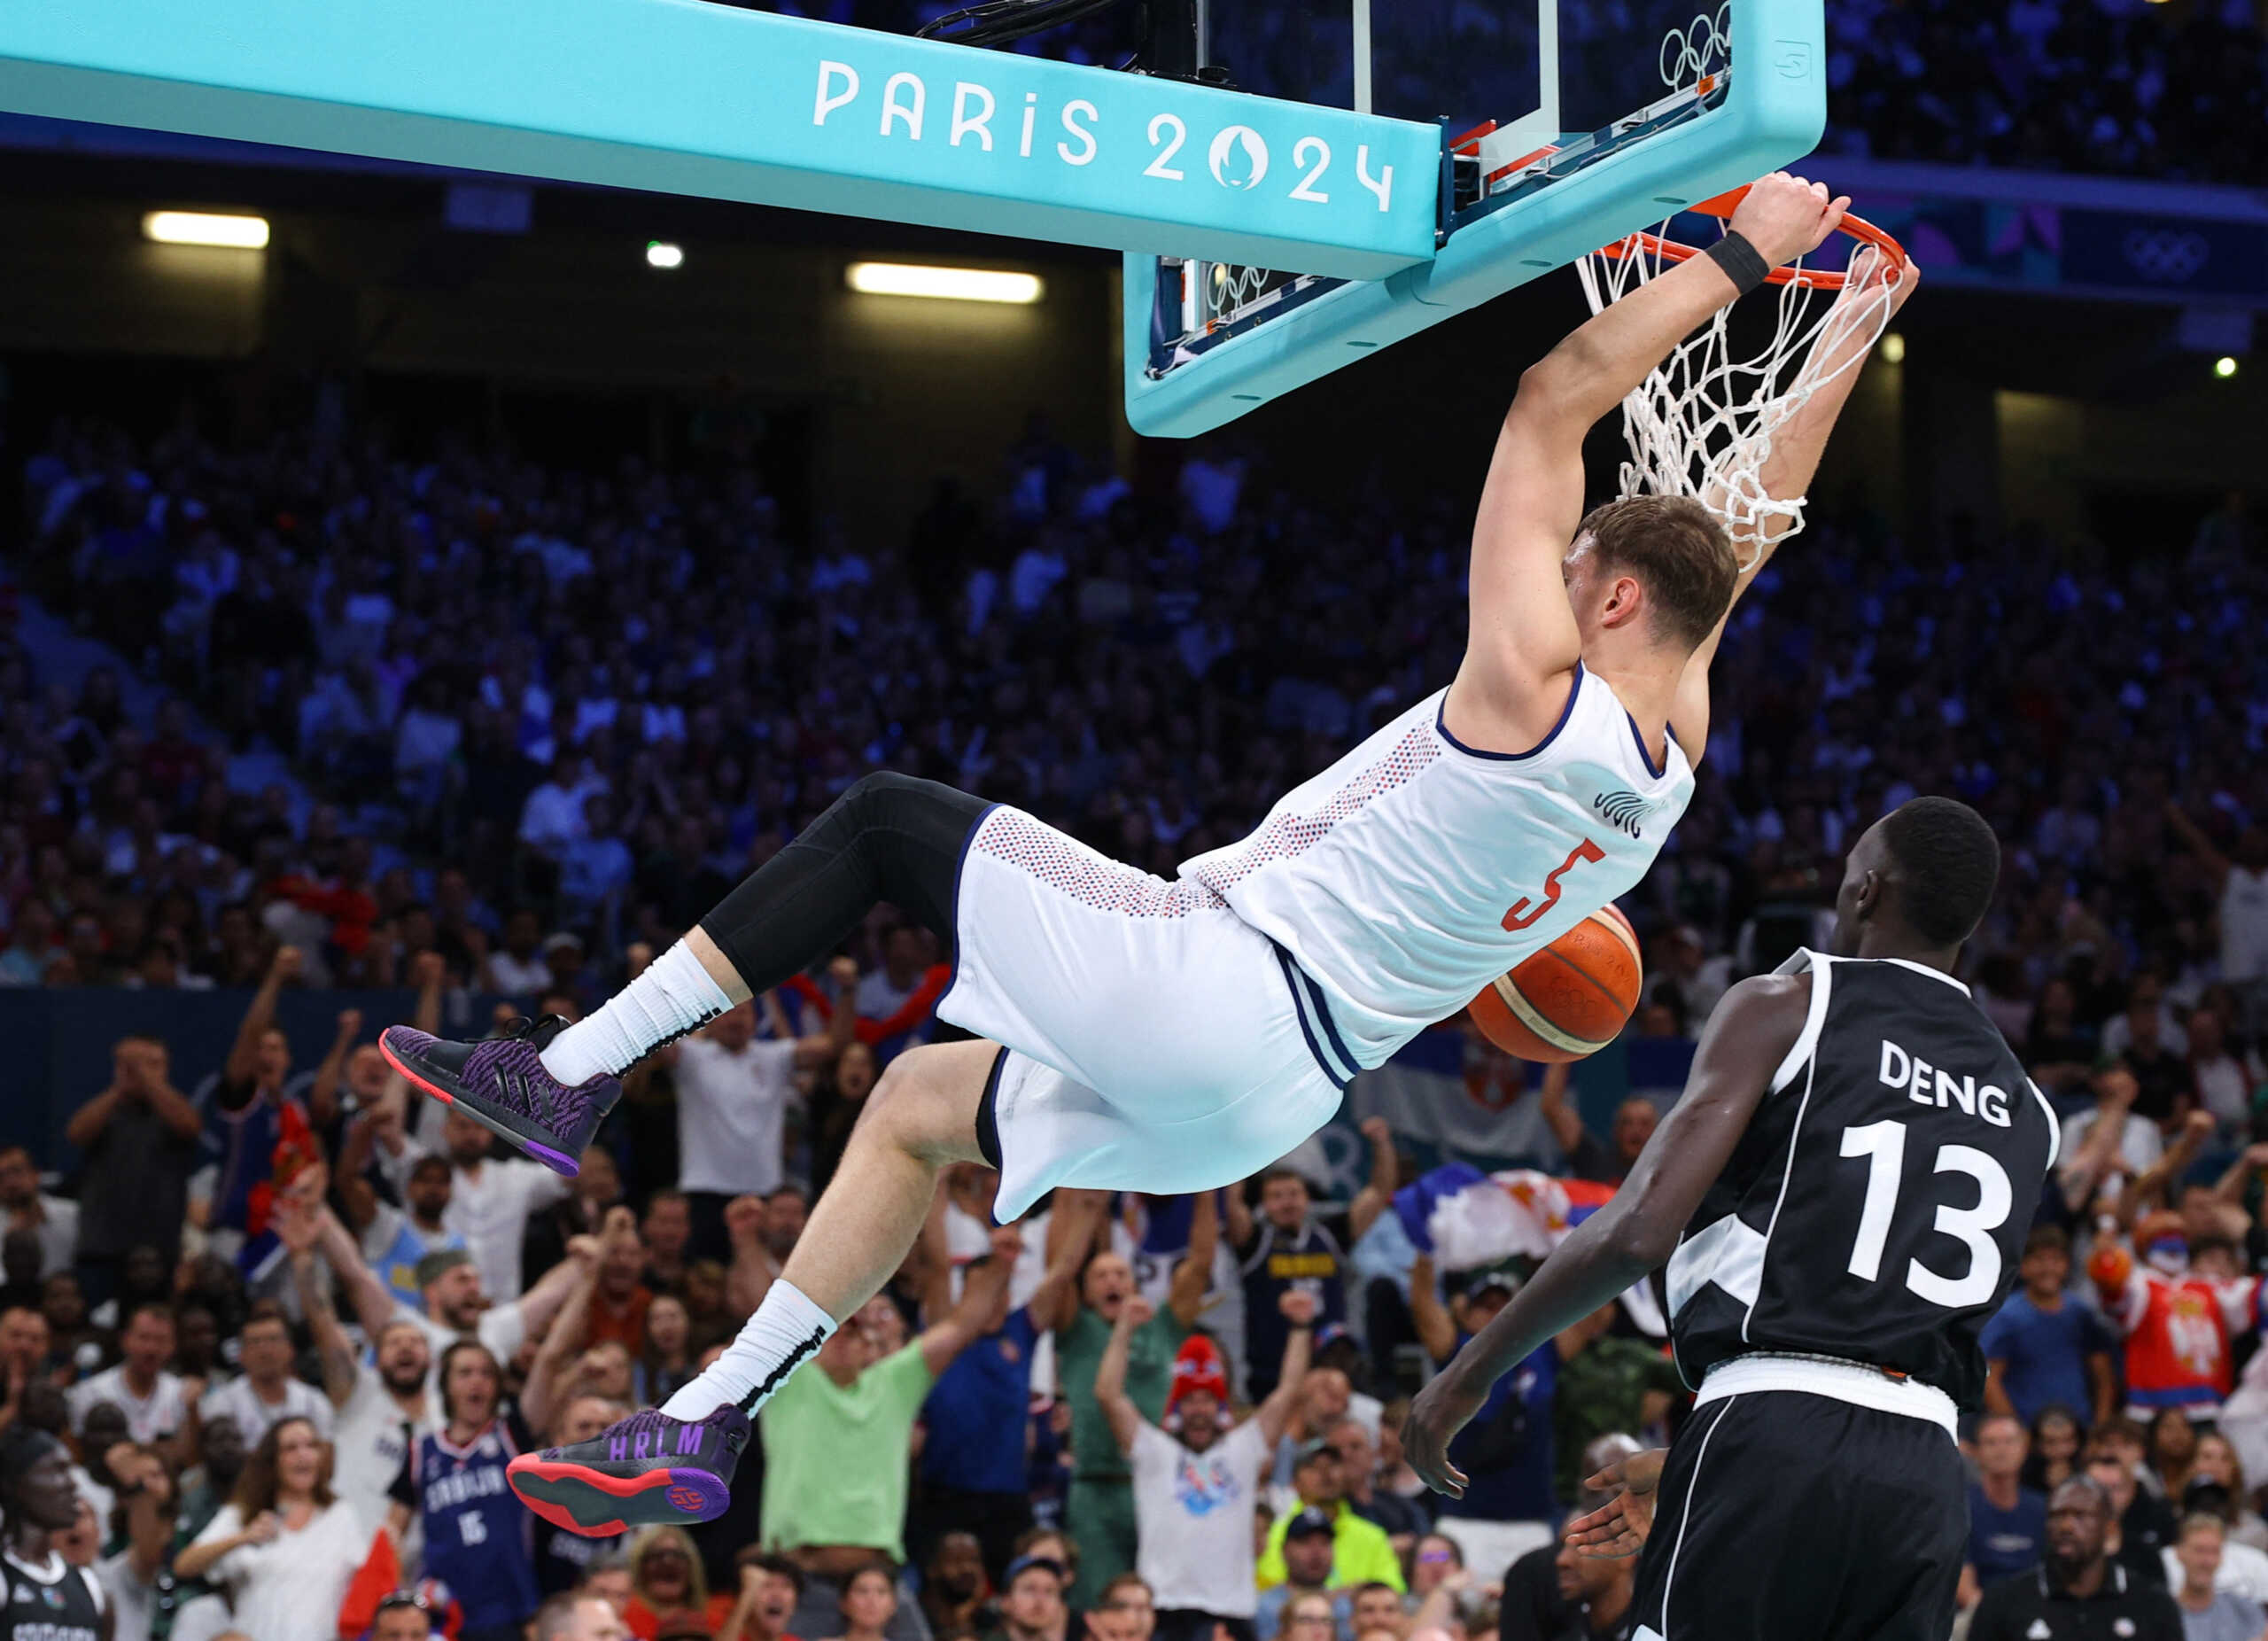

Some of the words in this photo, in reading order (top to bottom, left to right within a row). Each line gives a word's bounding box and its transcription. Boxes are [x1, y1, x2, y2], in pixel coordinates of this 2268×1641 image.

[1142, 113, 1394, 213] 2024
[1501, 837, 1607, 932] 5
[1879, 1039, 2012, 1128] DENG
[1839, 1119, 2013, 1309] 13
[609, 1424, 705, 1462] HRLM
